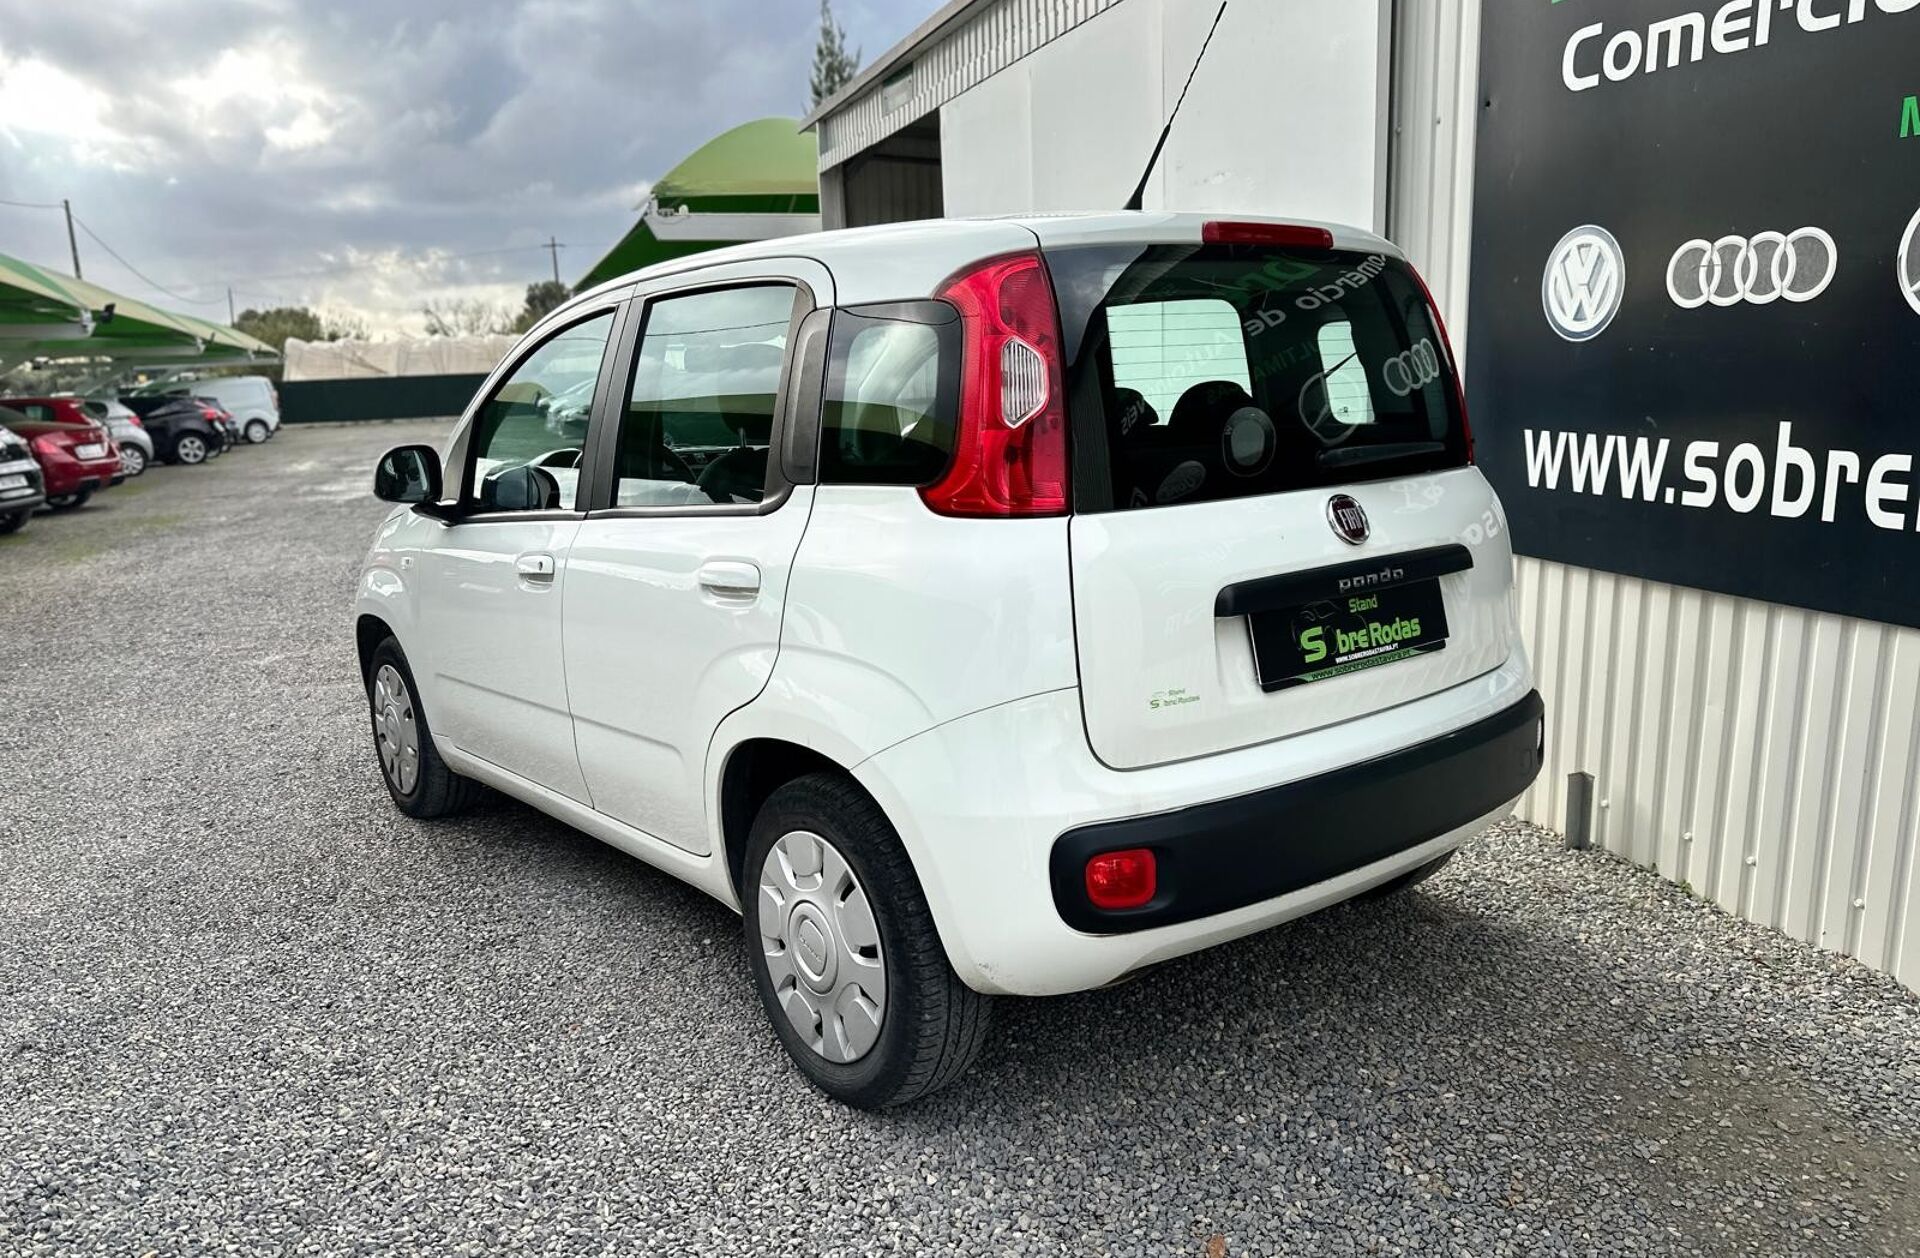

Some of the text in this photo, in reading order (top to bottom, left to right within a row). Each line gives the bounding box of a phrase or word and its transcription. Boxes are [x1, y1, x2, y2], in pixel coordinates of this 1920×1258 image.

[1524, 421, 1920, 534] www.sobre
[1349, 594, 1378, 614] Stand
[1369, 616, 1421, 647] Rodas
